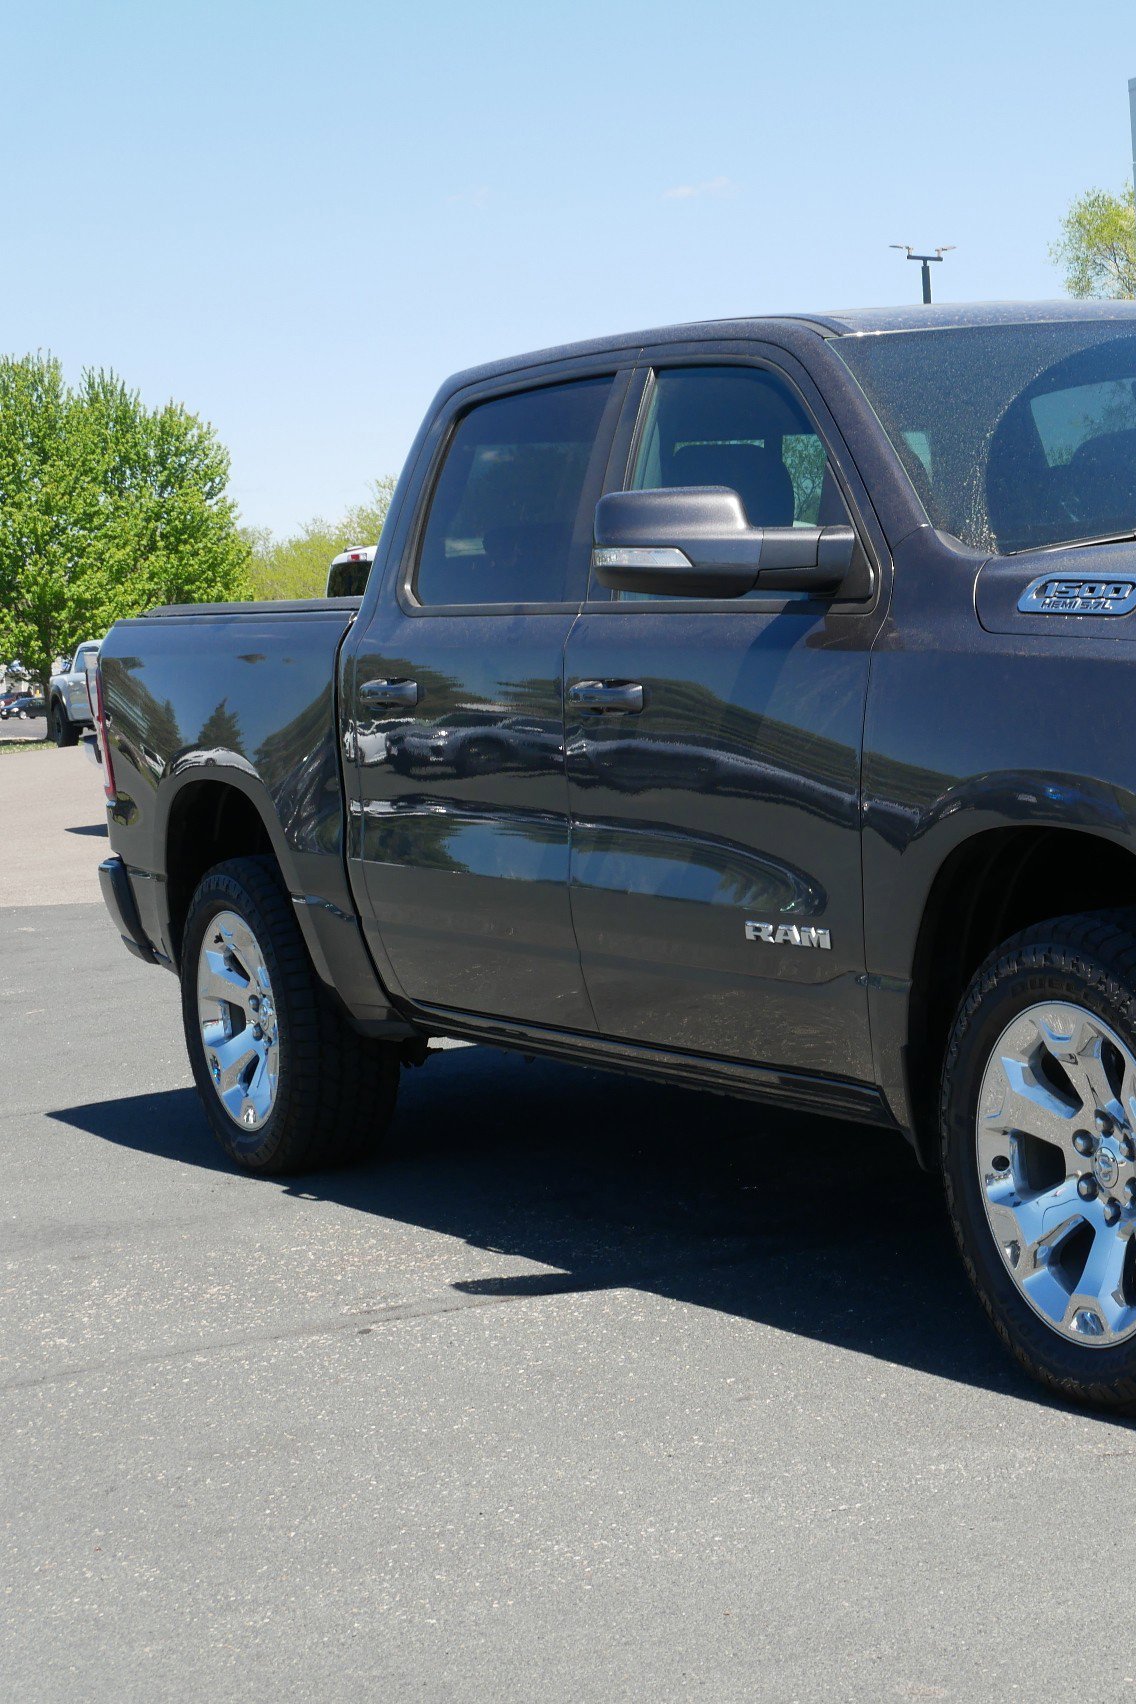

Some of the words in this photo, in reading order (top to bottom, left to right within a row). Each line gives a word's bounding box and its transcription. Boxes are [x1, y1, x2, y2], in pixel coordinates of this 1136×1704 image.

[1042, 581, 1133, 600] 1500
[1041, 599, 1079, 610] HEMI
[1080, 599, 1112, 610] 5.7L
[745, 920, 831, 950] RAM
